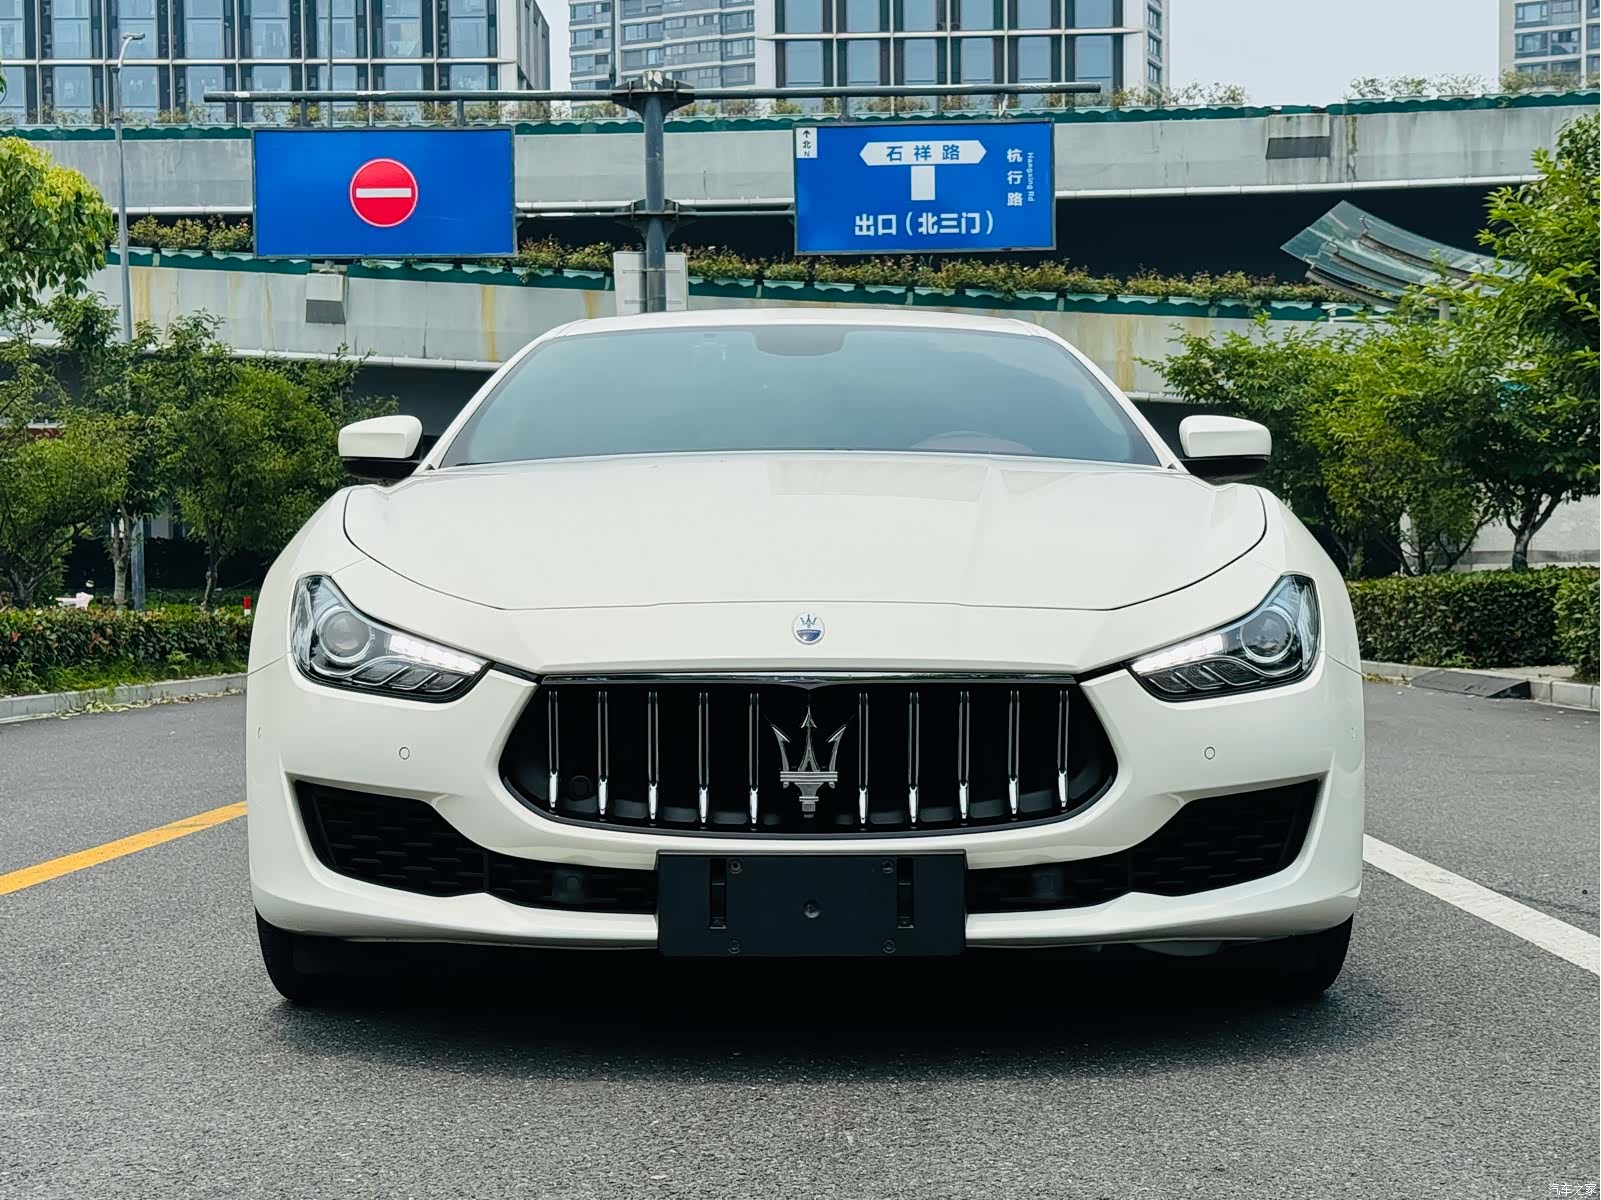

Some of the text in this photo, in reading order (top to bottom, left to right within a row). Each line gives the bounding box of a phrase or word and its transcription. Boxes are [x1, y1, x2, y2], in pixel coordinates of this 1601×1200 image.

[803, 140, 811, 149] 北
[886, 144, 960, 162] 石祥路
[1006, 148, 1023, 207] 杭行路
[1026, 152, 1035, 202] Hangxing Rd
